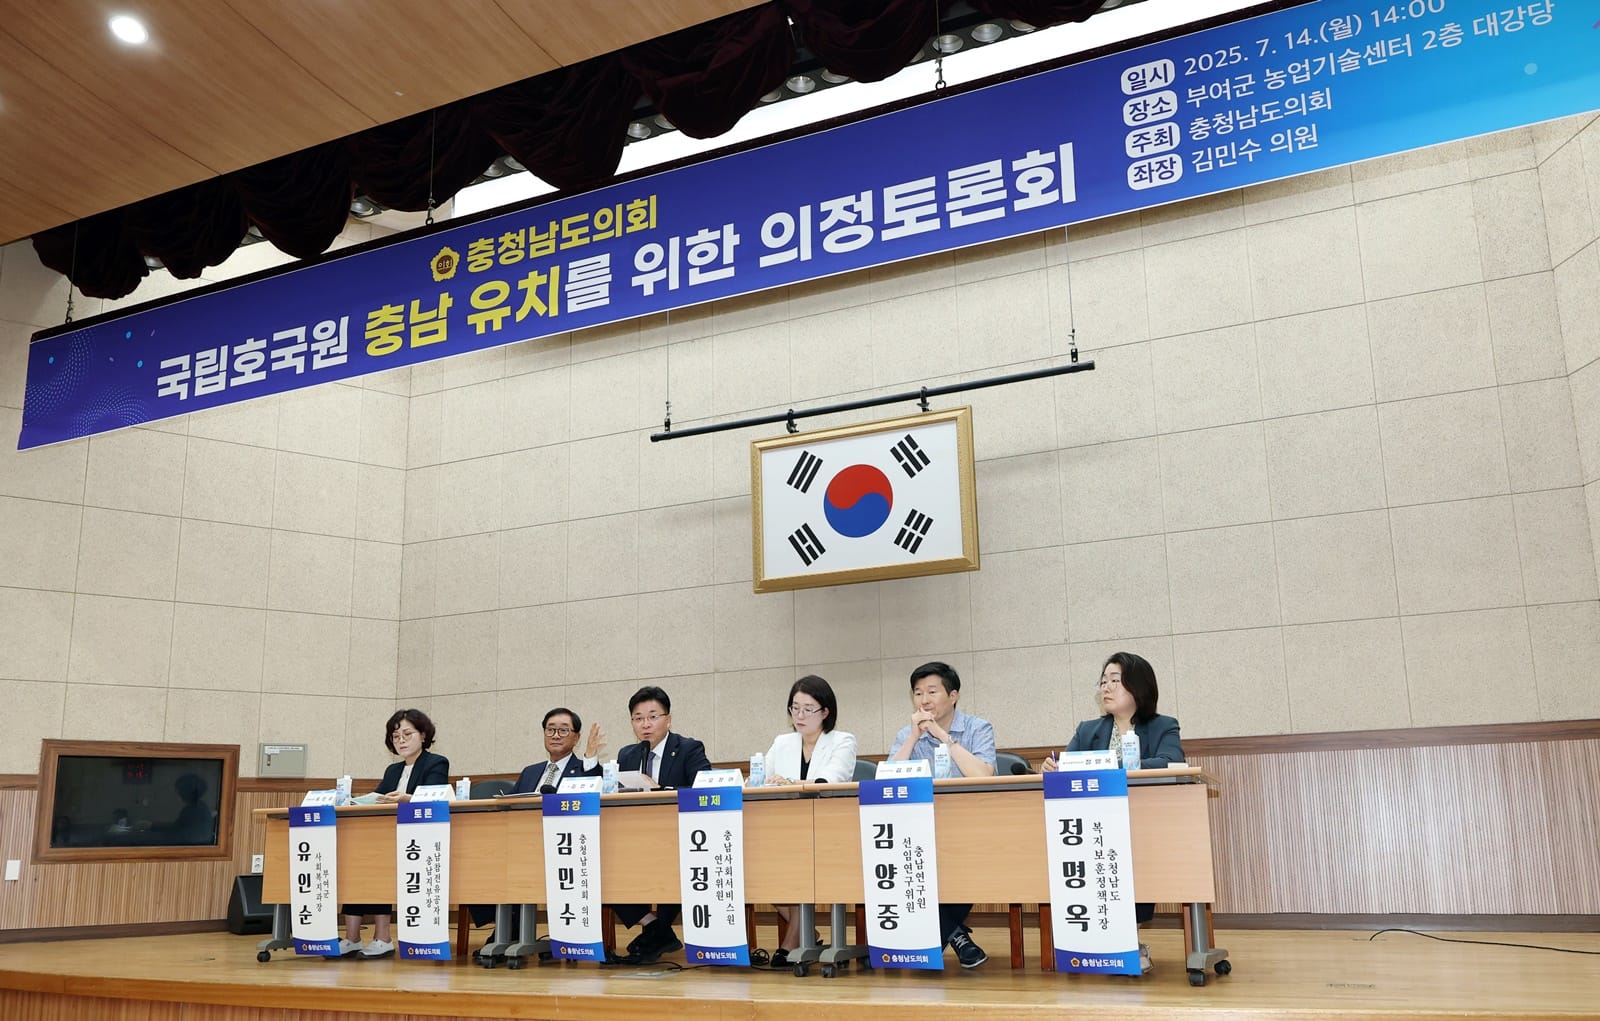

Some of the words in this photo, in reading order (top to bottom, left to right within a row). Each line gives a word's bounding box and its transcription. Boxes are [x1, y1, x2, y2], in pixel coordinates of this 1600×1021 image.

[1127, 64, 1170, 91] 일시
[1184, 44, 1248, 76] 2025.
[1256, 39, 1277, 57] 7.
[1284, 14, 1362, 49] 14.(월)
[1370, 0, 1446, 29] 14:00
[1129, 96, 1172, 121] 장소
[1186, 74, 1255, 107] 부여군
[1263, 35, 1413, 90] 농업기술센터
[1422, 22, 1464, 55] 2층
[1473, 1, 1555, 38] 대강당
[1132, 128, 1174, 153] 주최
[1189, 88, 1333, 141] 충청남도의회
[1133, 159, 1176, 184] 좌장
[1191, 140, 1262, 173] 김민수
[1270, 124, 1318, 154] 의원
[157, 316, 349, 400] 국립호국원
[364, 291, 453, 357] 충남
[467, 249, 612, 335] 유치를
[631, 223, 740, 296] 위한
[759, 141, 1077, 268] 의정토론회
[467, 195, 657, 273] 충청남도의회
[297, 841, 313, 925] 유인순
[405, 839, 421, 927] 송길운
[556, 832, 576, 926] 김민수
[579, 833, 589, 900] 충청남도의회
[689, 829, 711, 929] 오정아
[715, 854, 724, 901] 연구위원
[723, 830, 735, 925] 충남사회서비스원
[872, 823, 900, 930] 김양중
[902, 837, 915, 913] 선임연구위원
[914, 846, 926, 909] 충남연구원
[1058, 818, 1090, 932] 정명옥
[1092, 822, 1110, 930] 복지보훈정책과장
[1107, 849, 1120, 902] 충청남도
[567, 947, 594, 956] 충청남도의회
[581, 906, 589, 927] 의원
[705, 951, 737, 960] 충청남도의회
[892, 954, 929, 964] 충청남도의회
[1082, 958, 1124, 968] 충청남도의회
